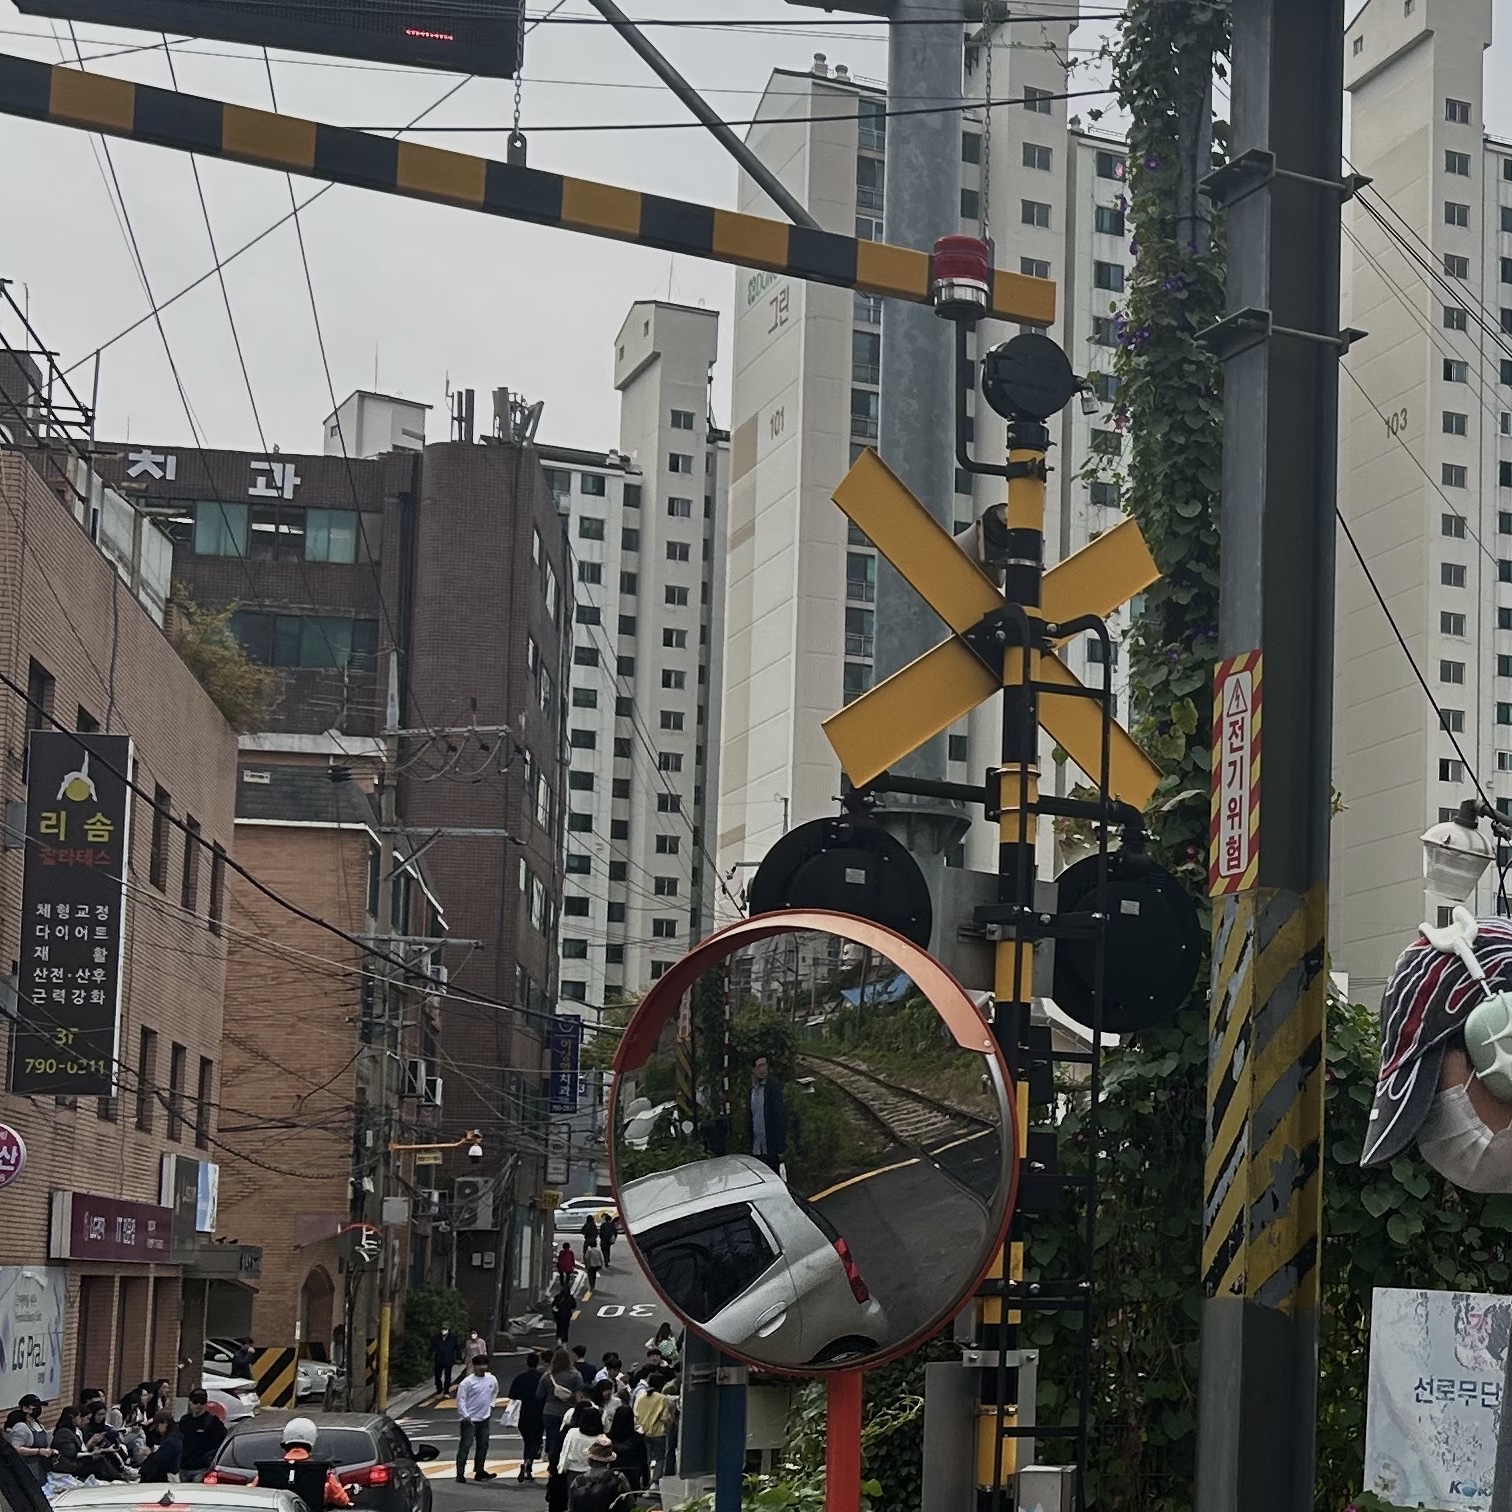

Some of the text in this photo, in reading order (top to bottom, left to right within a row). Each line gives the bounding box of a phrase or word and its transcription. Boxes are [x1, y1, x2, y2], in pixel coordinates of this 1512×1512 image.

[767, 284, 790, 335] 그린
[769, 405, 785, 440] 101
[1385, 407, 1408, 439] 103
[1226, 716, 1245, 873] 전기위험
[39, 810, 115, 842] 리솜
[35, 903, 110, 920] 체형교정
[35, 924, 110, 942] 다이어트
[31, 987, 106, 1006] 근력강화
[54, 1027, 79, 1045] 3F
[1414, 1377, 1502, 1408] 선로무단
